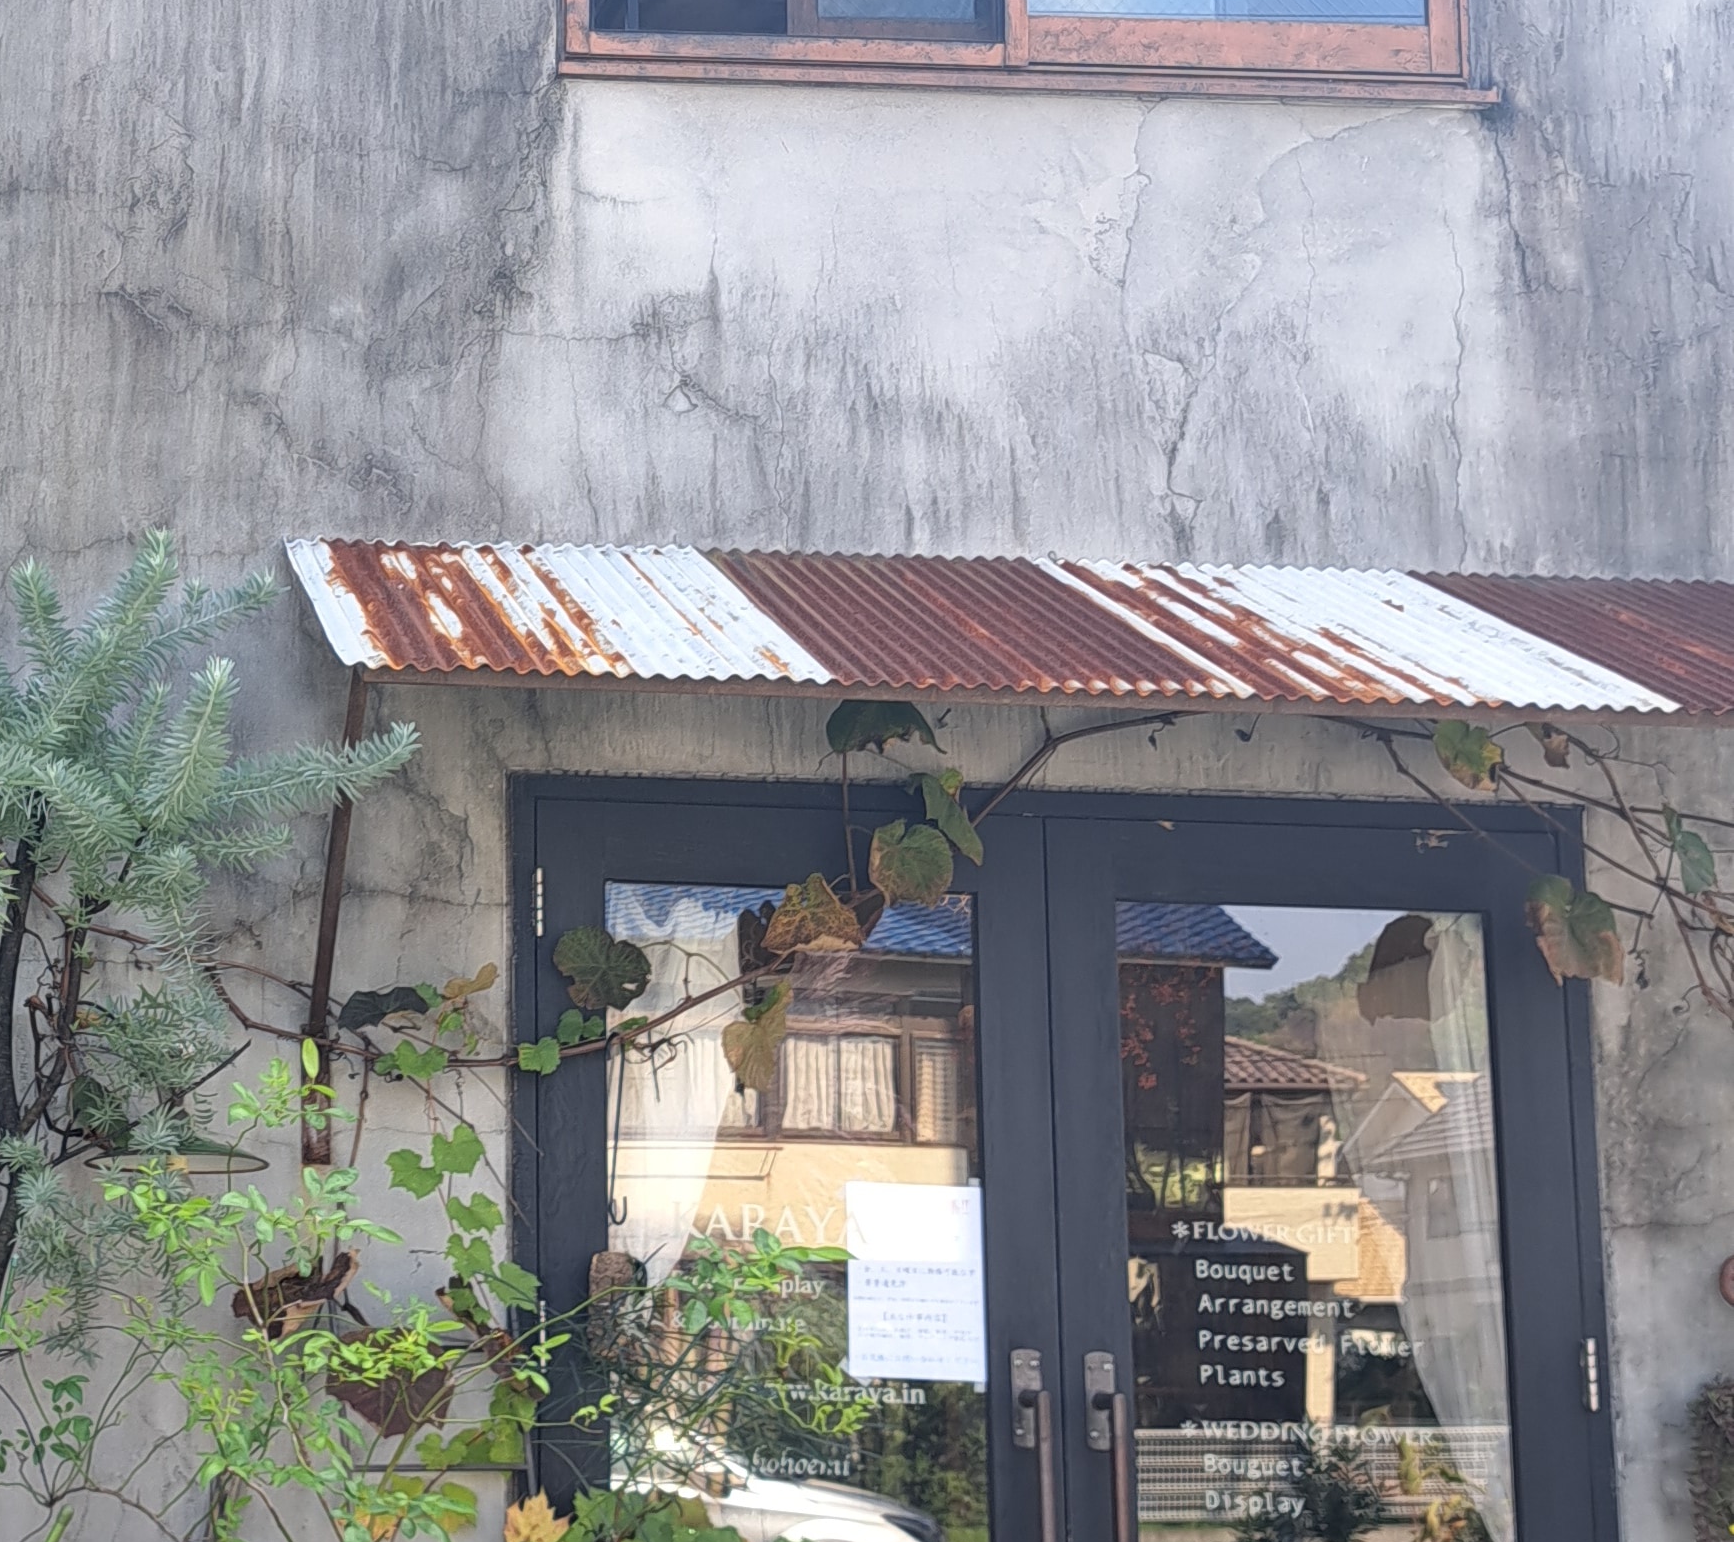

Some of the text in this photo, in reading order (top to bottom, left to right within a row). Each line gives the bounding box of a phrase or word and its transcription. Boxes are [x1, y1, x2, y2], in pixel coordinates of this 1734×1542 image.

[672, 1201, 868, 1245] KARAYA
[1193, 1221, 1355, 1245] FLOWER GIFT
[1195, 1258, 1296, 1285] Bouquet
[1197, 1293, 1357, 1321] Arrangement
[1198, 1329, 1425, 1358] Presarved Flower
[1199, 1364, 1286, 1387] Plants
[1201, 1420, 1434, 1447] WEDDING FLOWER
[1204, 1489, 1307, 1519] Display
